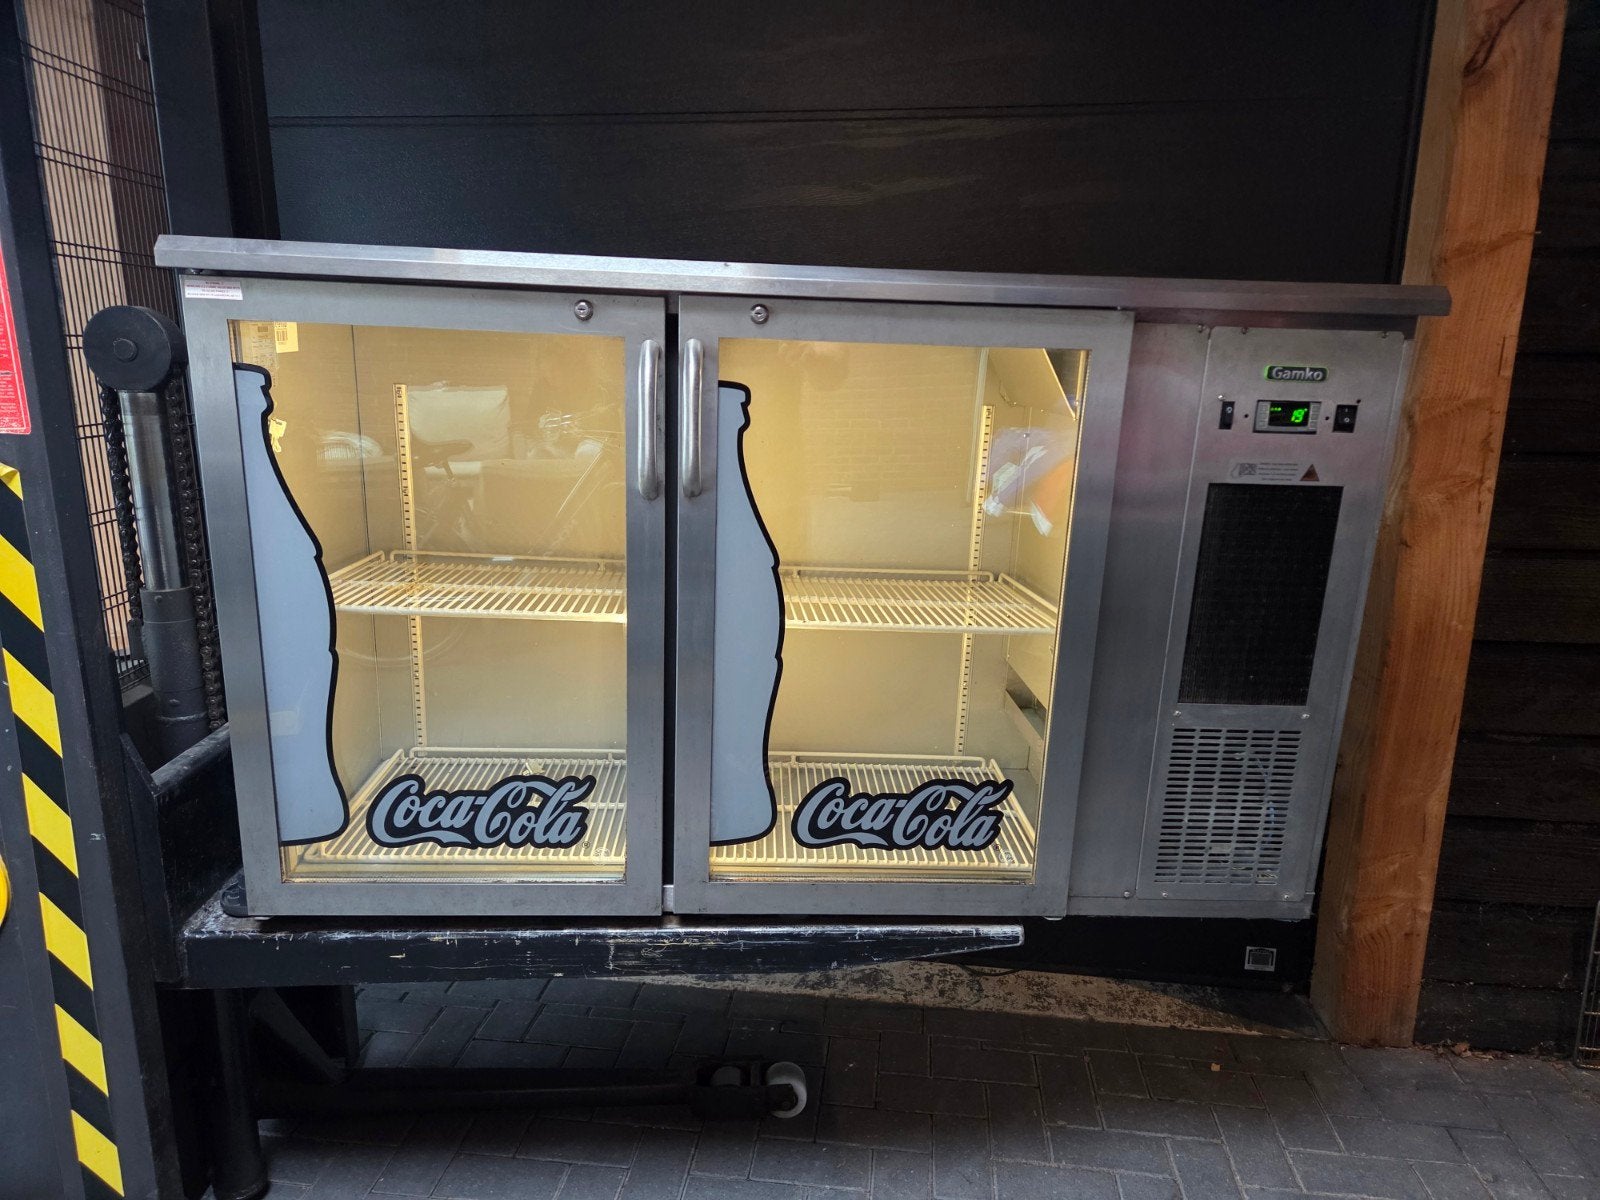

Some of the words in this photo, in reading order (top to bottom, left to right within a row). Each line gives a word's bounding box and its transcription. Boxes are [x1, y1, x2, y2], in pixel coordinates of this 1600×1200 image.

[1271, 366, 1324, 381] Gamko
[371, 779, 592, 845] Coca-Cola
[796, 782, 1007, 848] Coca-Cola
